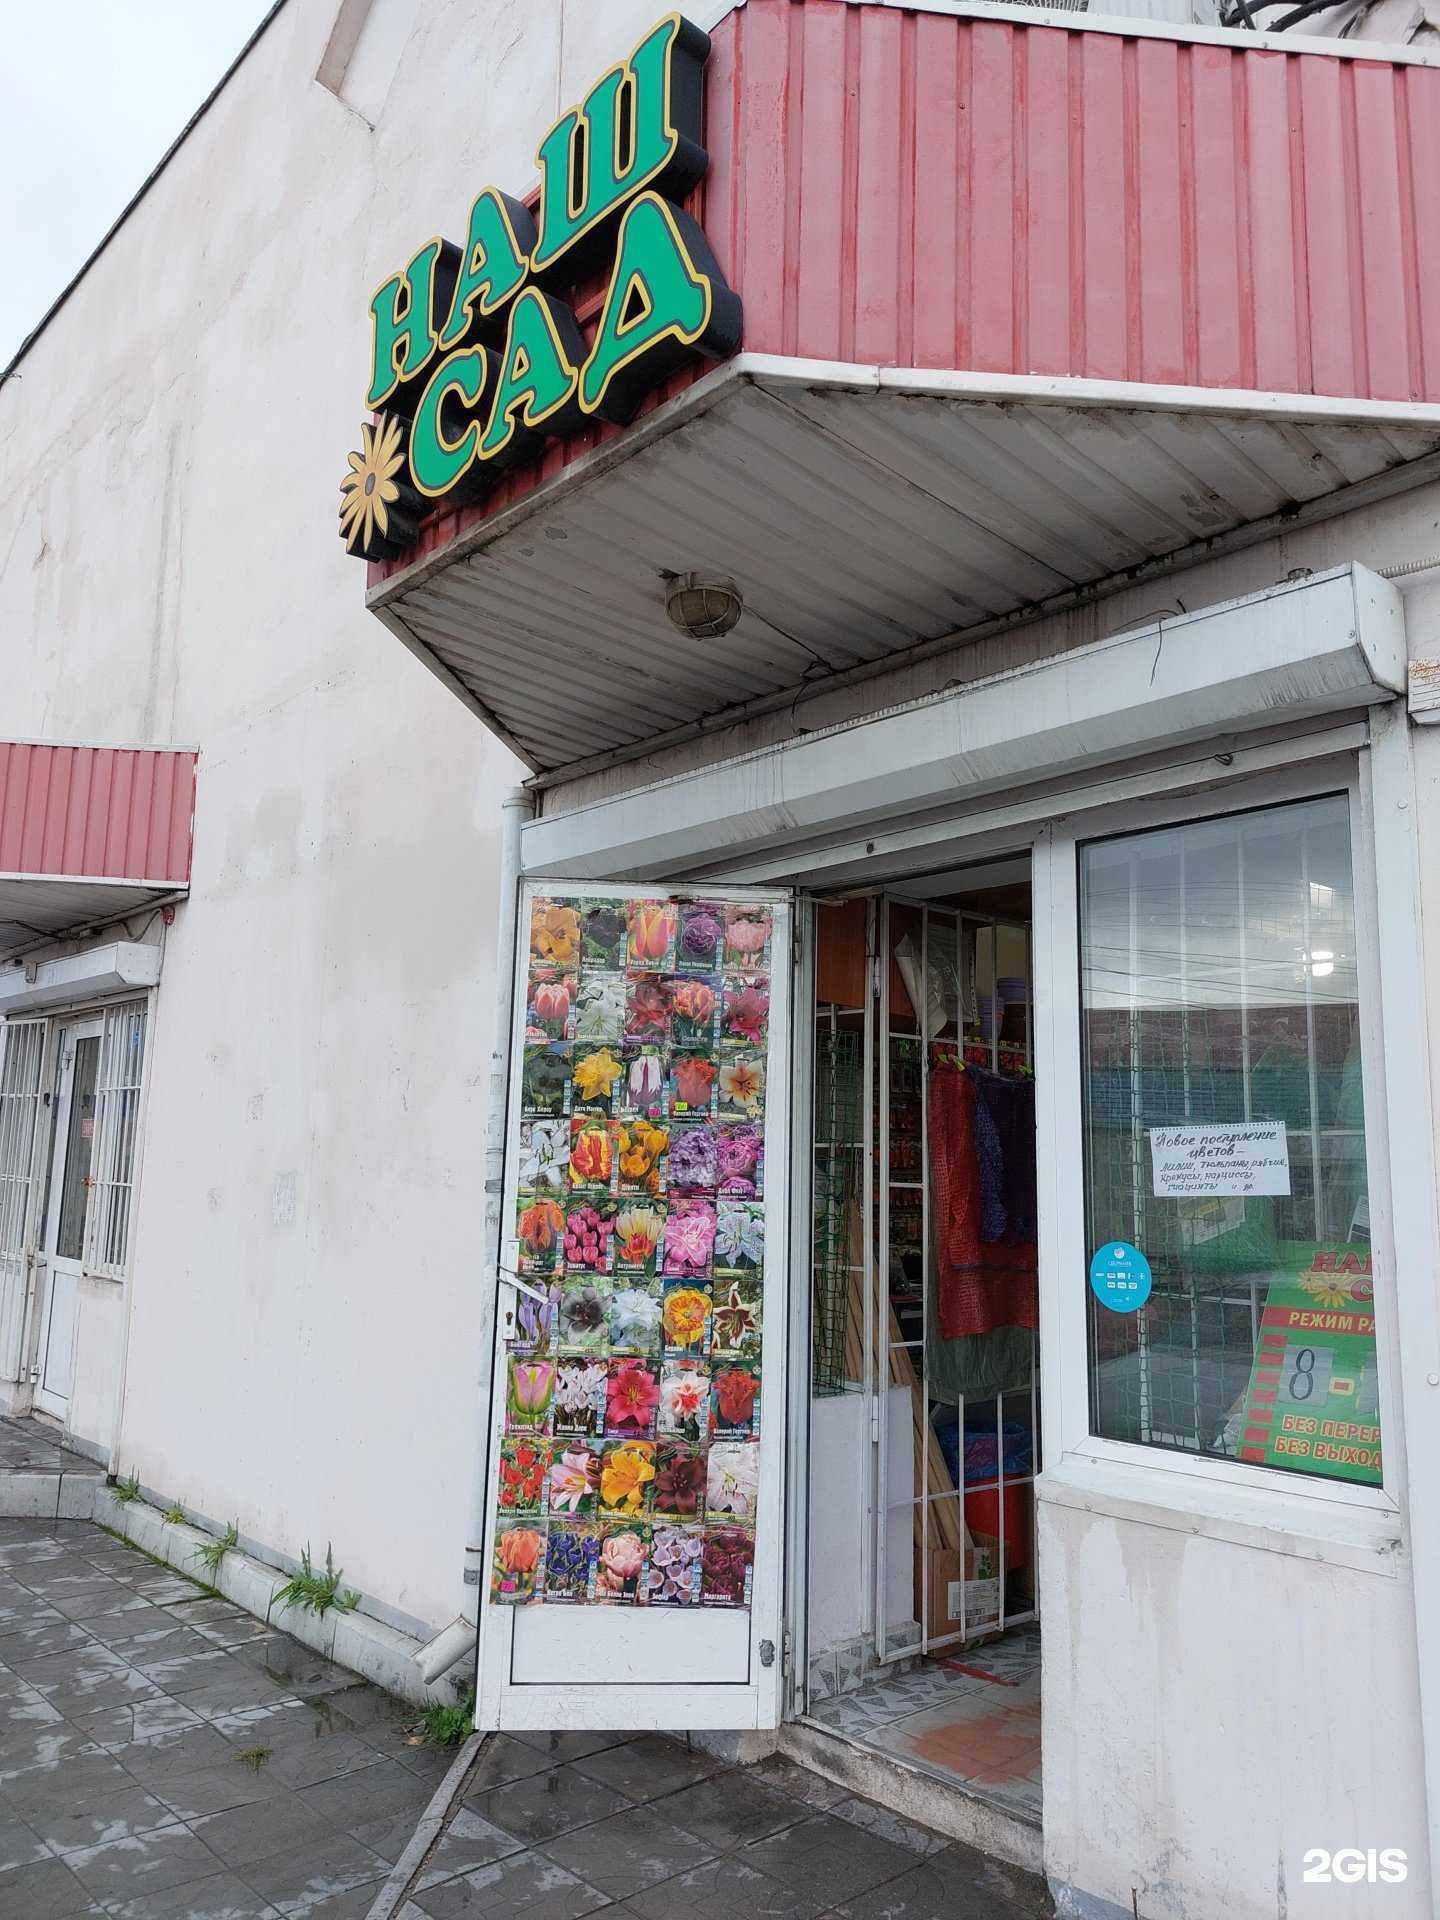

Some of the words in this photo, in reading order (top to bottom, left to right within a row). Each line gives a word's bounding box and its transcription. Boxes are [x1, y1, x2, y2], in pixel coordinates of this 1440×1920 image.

[364, 11, 682, 412] НАШ
[409, 190, 711, 497] САД
[1155, 1132, 1196, 1148] Новое
[1200, 1130, 1278, 1145] поступление
[1289, 1311, 1352, 1331] РЕЖИМ
[1288, 1348, 1315, 1401] 8
[1282, 1414, 1317, 1435] БЕЗ
[1275, 1435, 1310, 1457] БЕЗ
